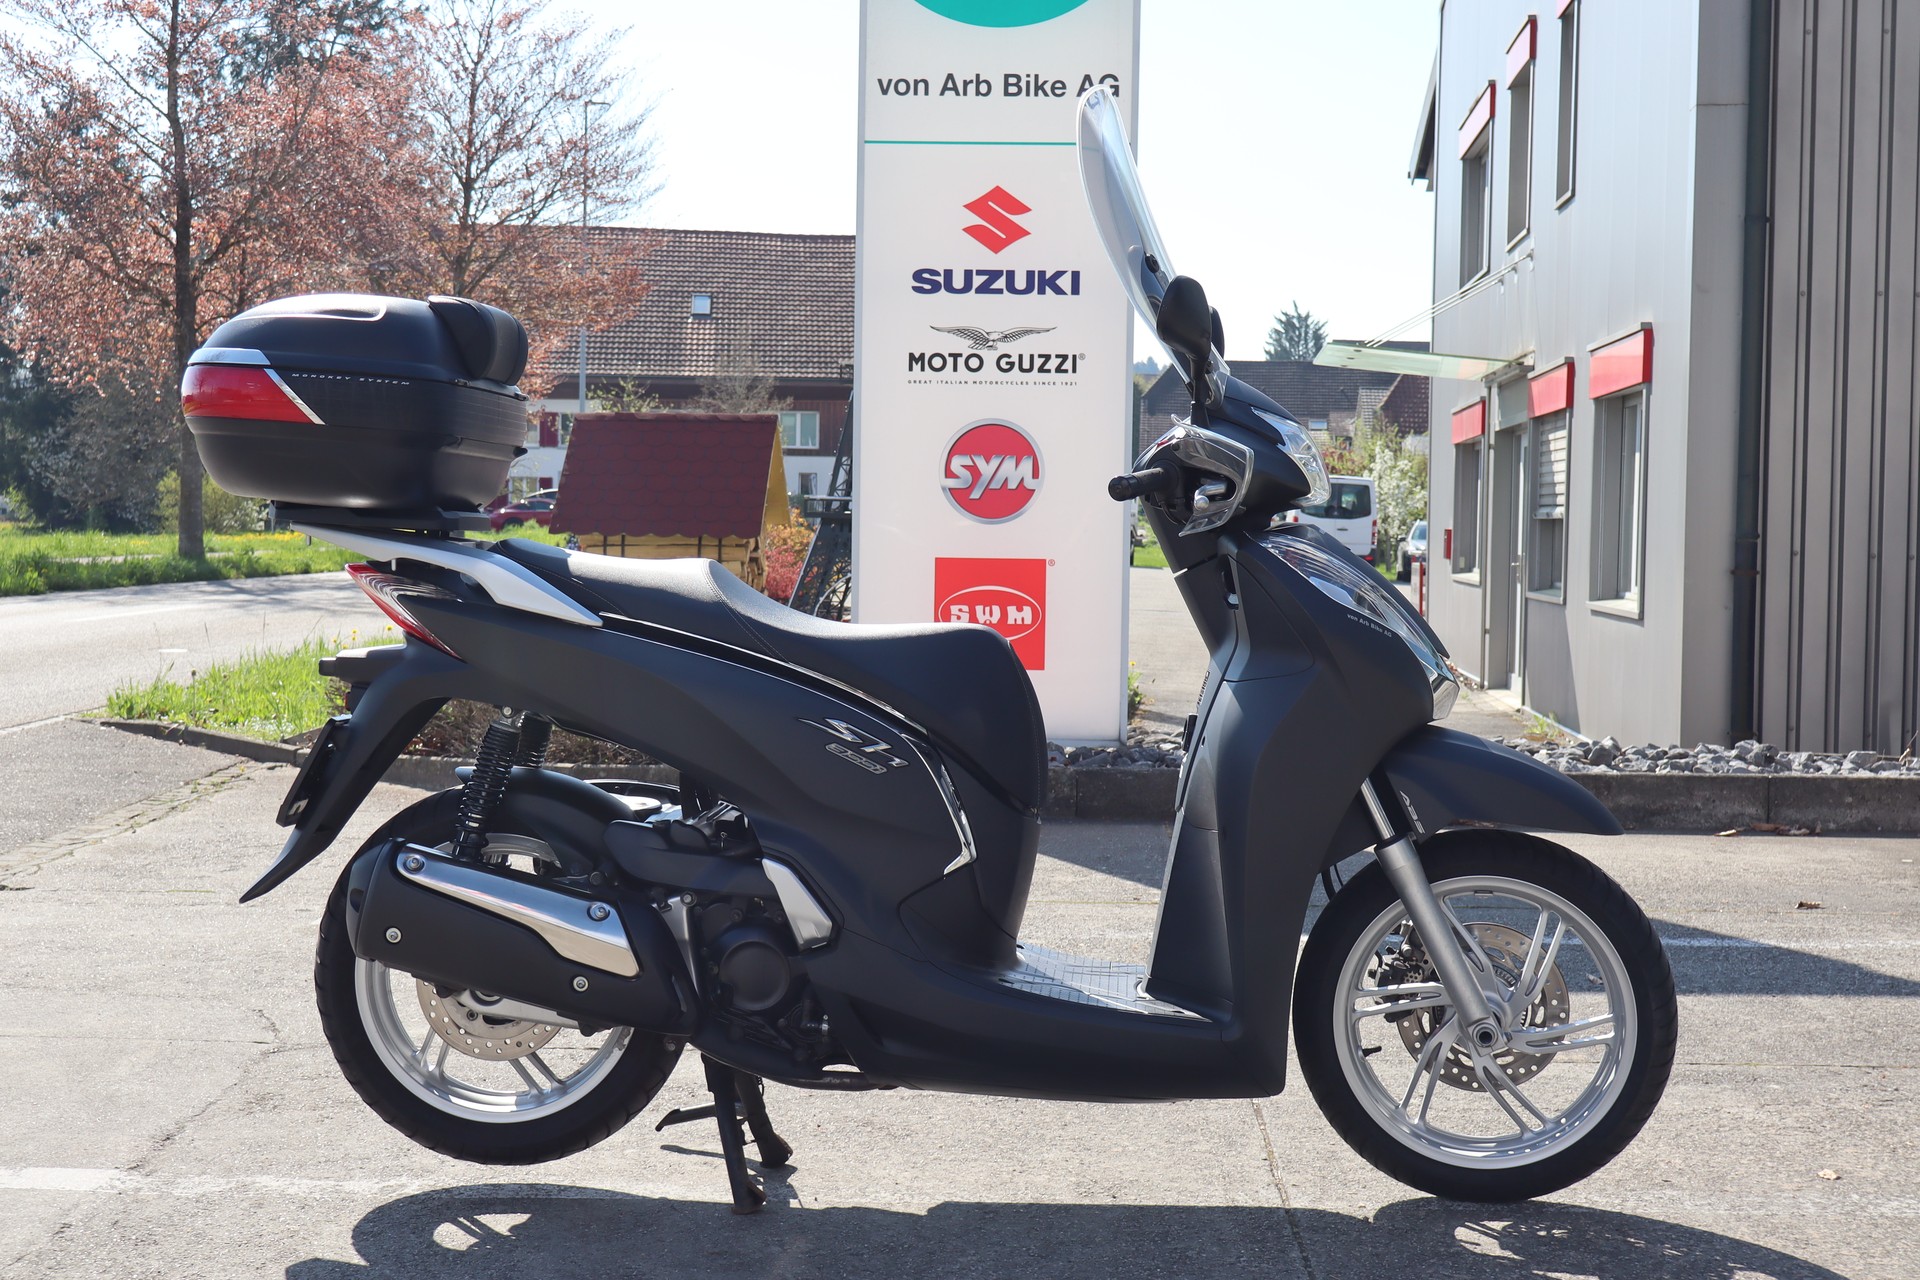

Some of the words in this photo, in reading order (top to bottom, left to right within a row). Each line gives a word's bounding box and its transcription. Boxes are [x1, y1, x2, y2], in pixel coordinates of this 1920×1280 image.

[877, 78, 929, 96] von
[939, 73, 992, 97] Arb
[1003, 73, 1067, 98] Bike
[911, 268, 1081, 296] SUZUKI
[908, 352, 985, 373] MOTO
[359, 377, 410, 385] SYSTEM
[941, 454, 1043, 500] SYM
[950, 604, 1033, 625] SWM
[1347, 613, 1358, 621] von
[1359, 618, 1370, 626] Arb
